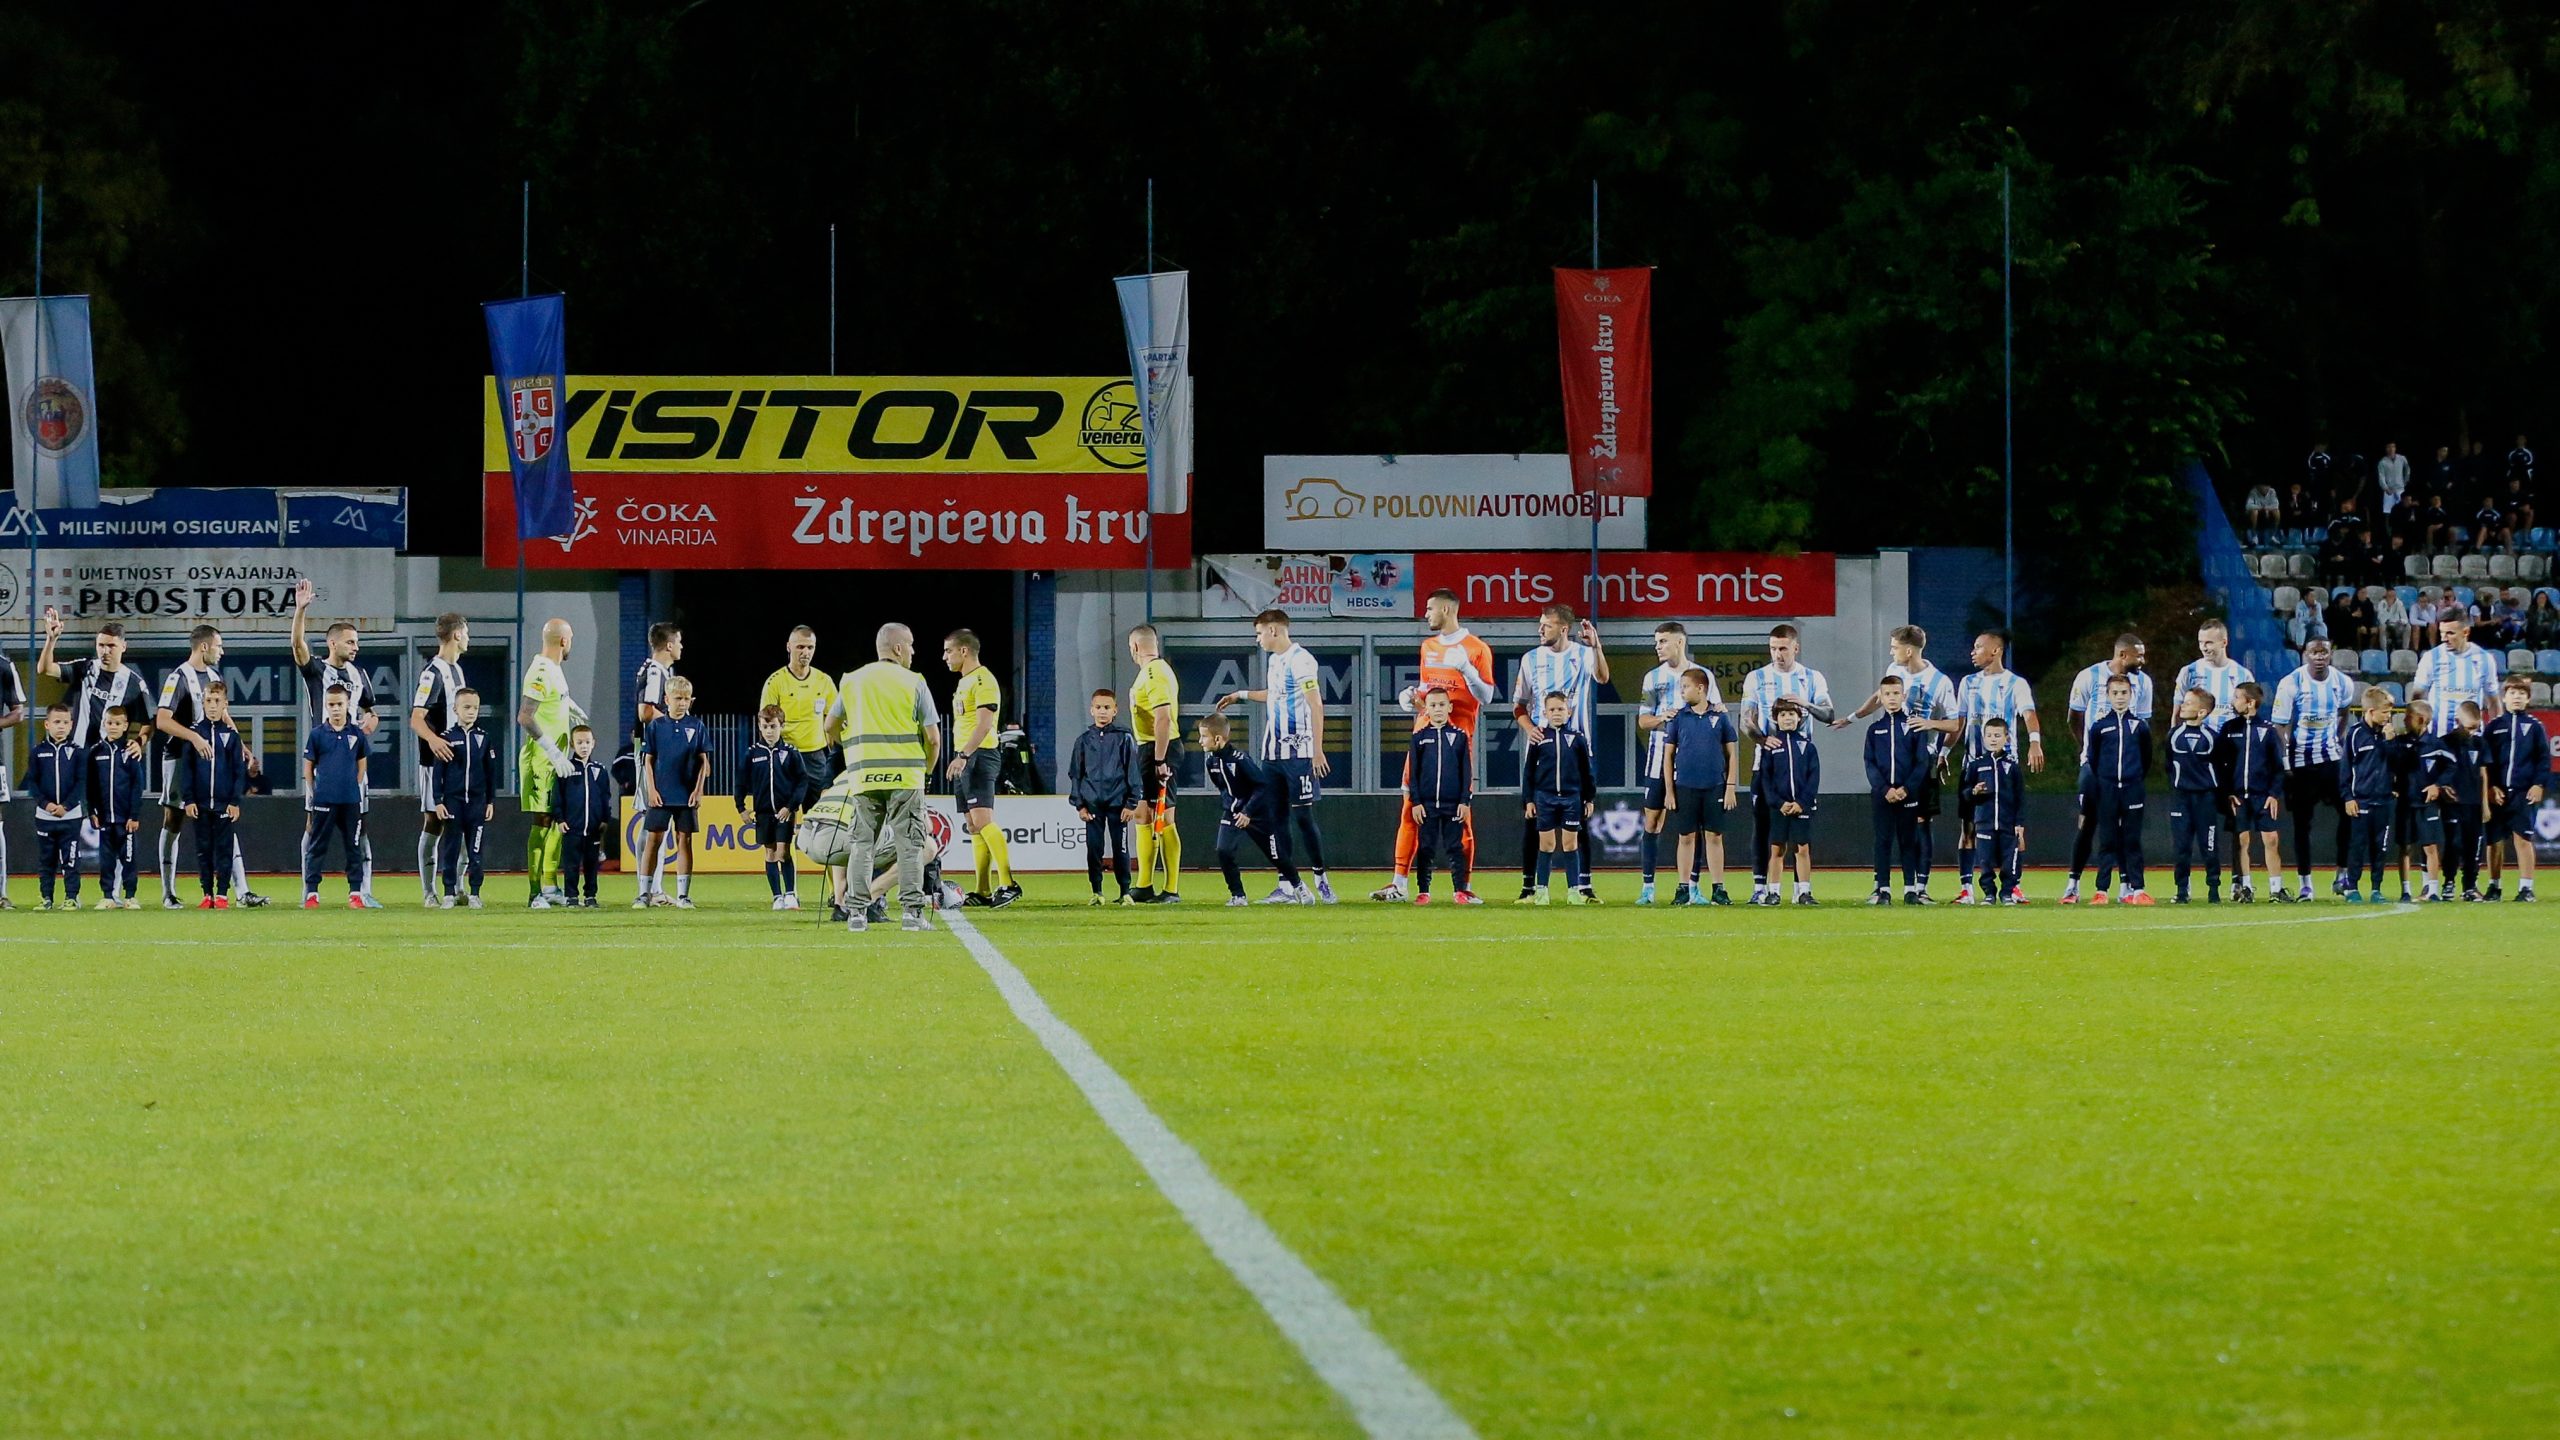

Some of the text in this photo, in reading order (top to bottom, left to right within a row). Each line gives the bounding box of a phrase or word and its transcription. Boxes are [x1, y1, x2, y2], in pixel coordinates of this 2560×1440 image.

[1082, 431, 1145, 445] venera
[616, 497, 718, 522] ČOKA
[59, 519, 301, 535] MILENIJUM OSIGURANE
[791, 484, 1149, 558] Ždrepčeva krv
[616, 528, 718, 545] VINARIJA
[79, 566, 297, 580] UMETNOST OSVAJANJA
[1466, 566, 1784, 603] mts mts mts
[79, 587, 297, 615] PROSTORA
[1347, 597, 1379, 607] HBCS
[1299, 775, 1313, 794] 16
